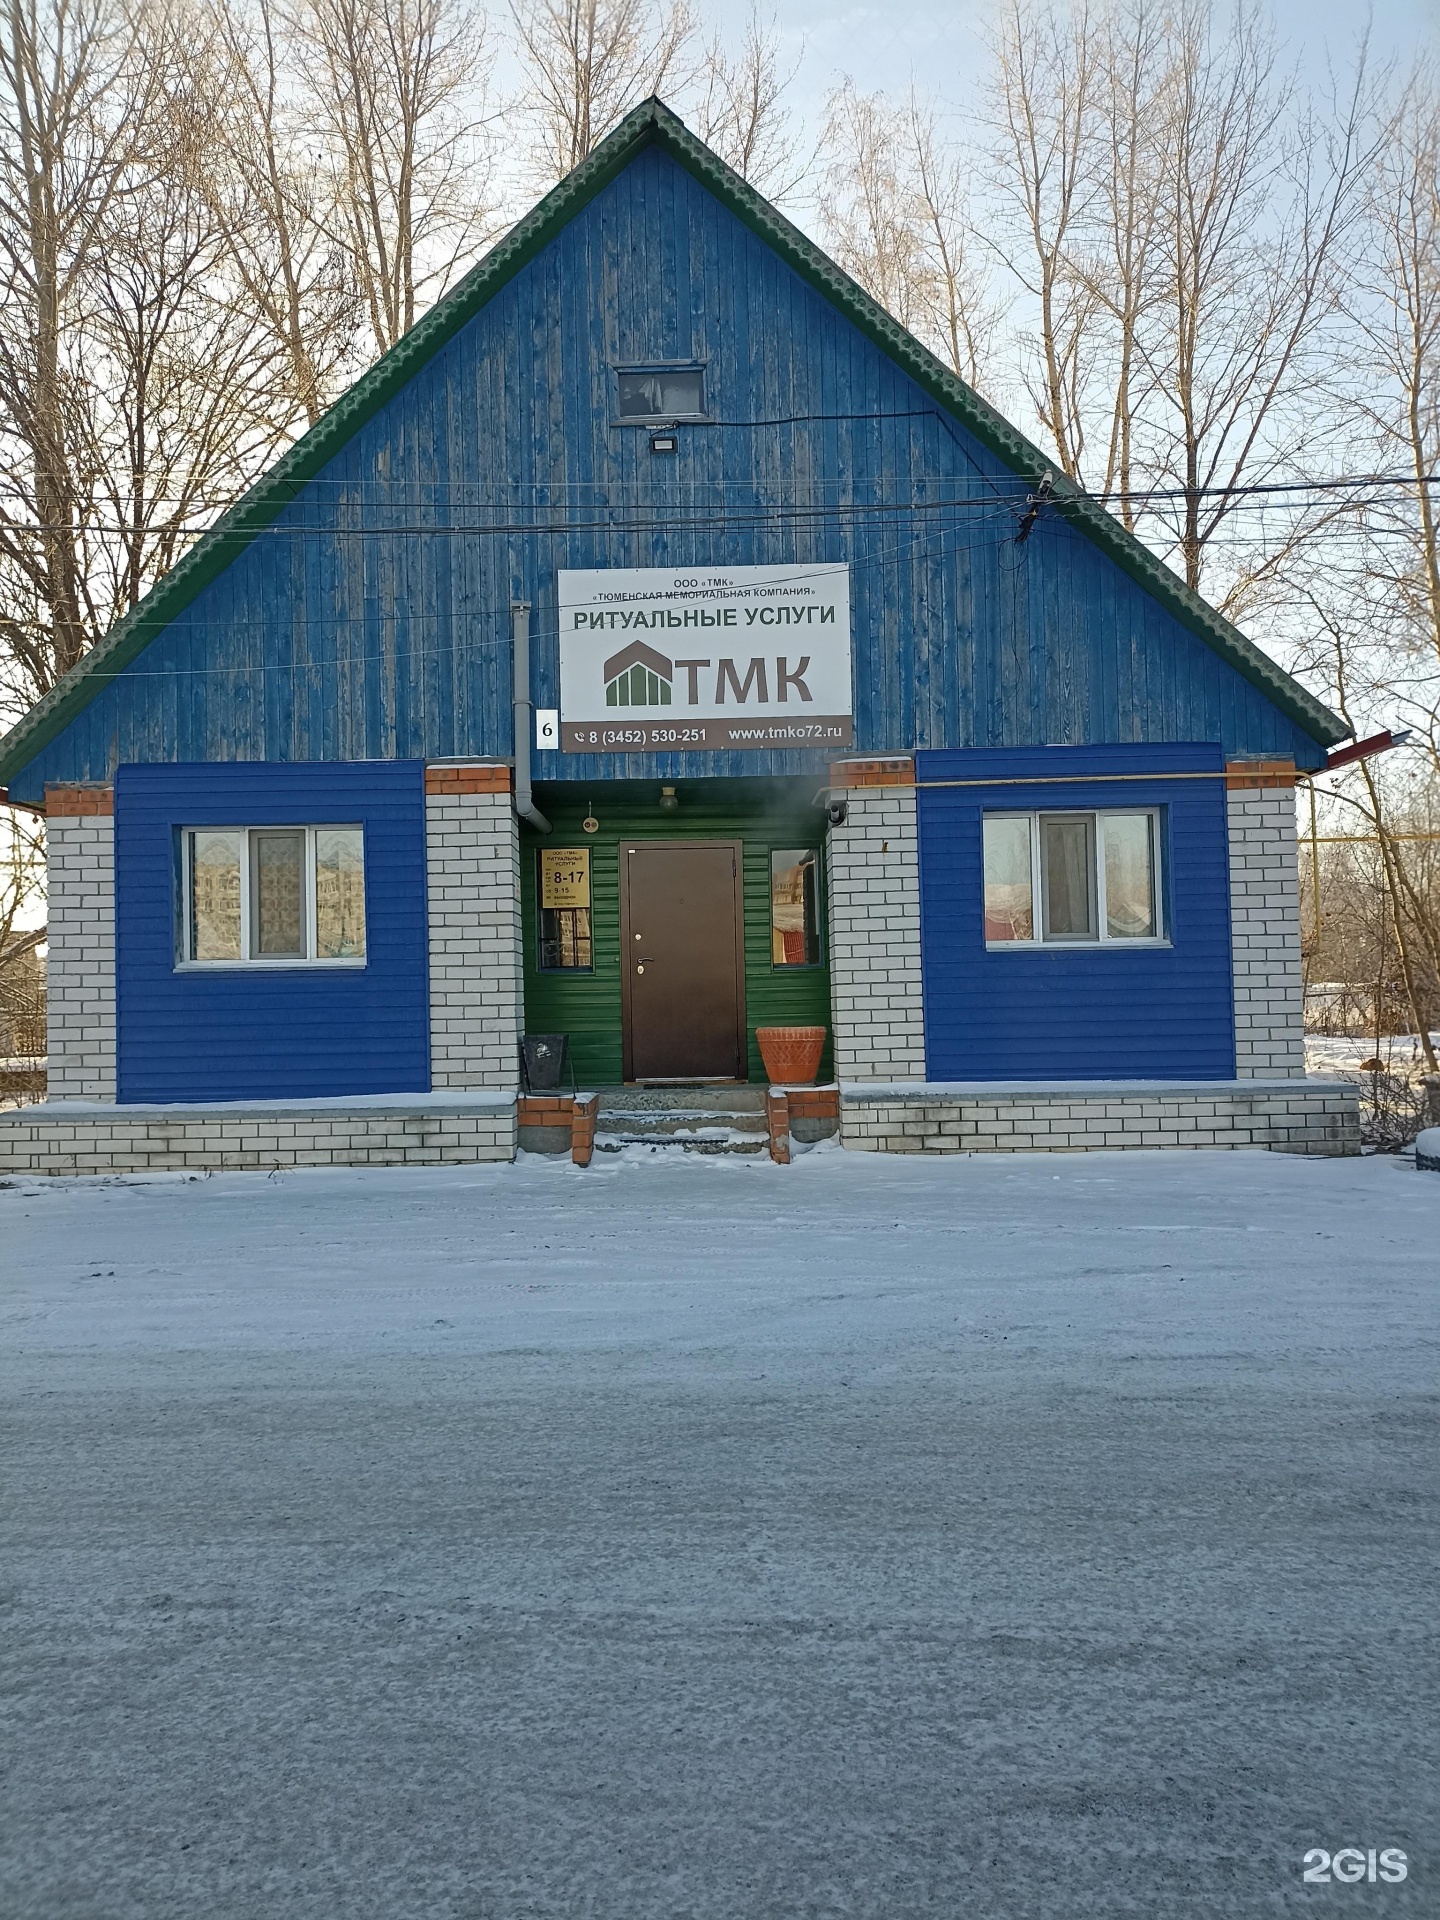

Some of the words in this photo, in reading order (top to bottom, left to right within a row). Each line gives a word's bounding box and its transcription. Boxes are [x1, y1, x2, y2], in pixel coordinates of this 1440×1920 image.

[674, 579, 698, 588] ООО
[701, 578, 734, 587] «ТМК»
[593, 591, 662, 601] «ТЮМЕНСКАЯ
[665, 590, 751, 600] МЕМОРИАЛЬНАЯ
[754, 587, 815, 597] КОМПАНИЯ»
[574, 608, 737, 629] РИТУАЛЬНЫЕ
[744, 605, 835, 626] УСЛУГИ
[674, 656, 813, 705] ТМК
[542, 723, 553, 737] 6
[589, 731, 598, 744] 8
[602, 729, 647, 746] (3452)
[651, 728, 707, 743] 530-251
[728, 725, 842, 740] www.tmko72.ru
[554, 871, 584, 883] 8-17
